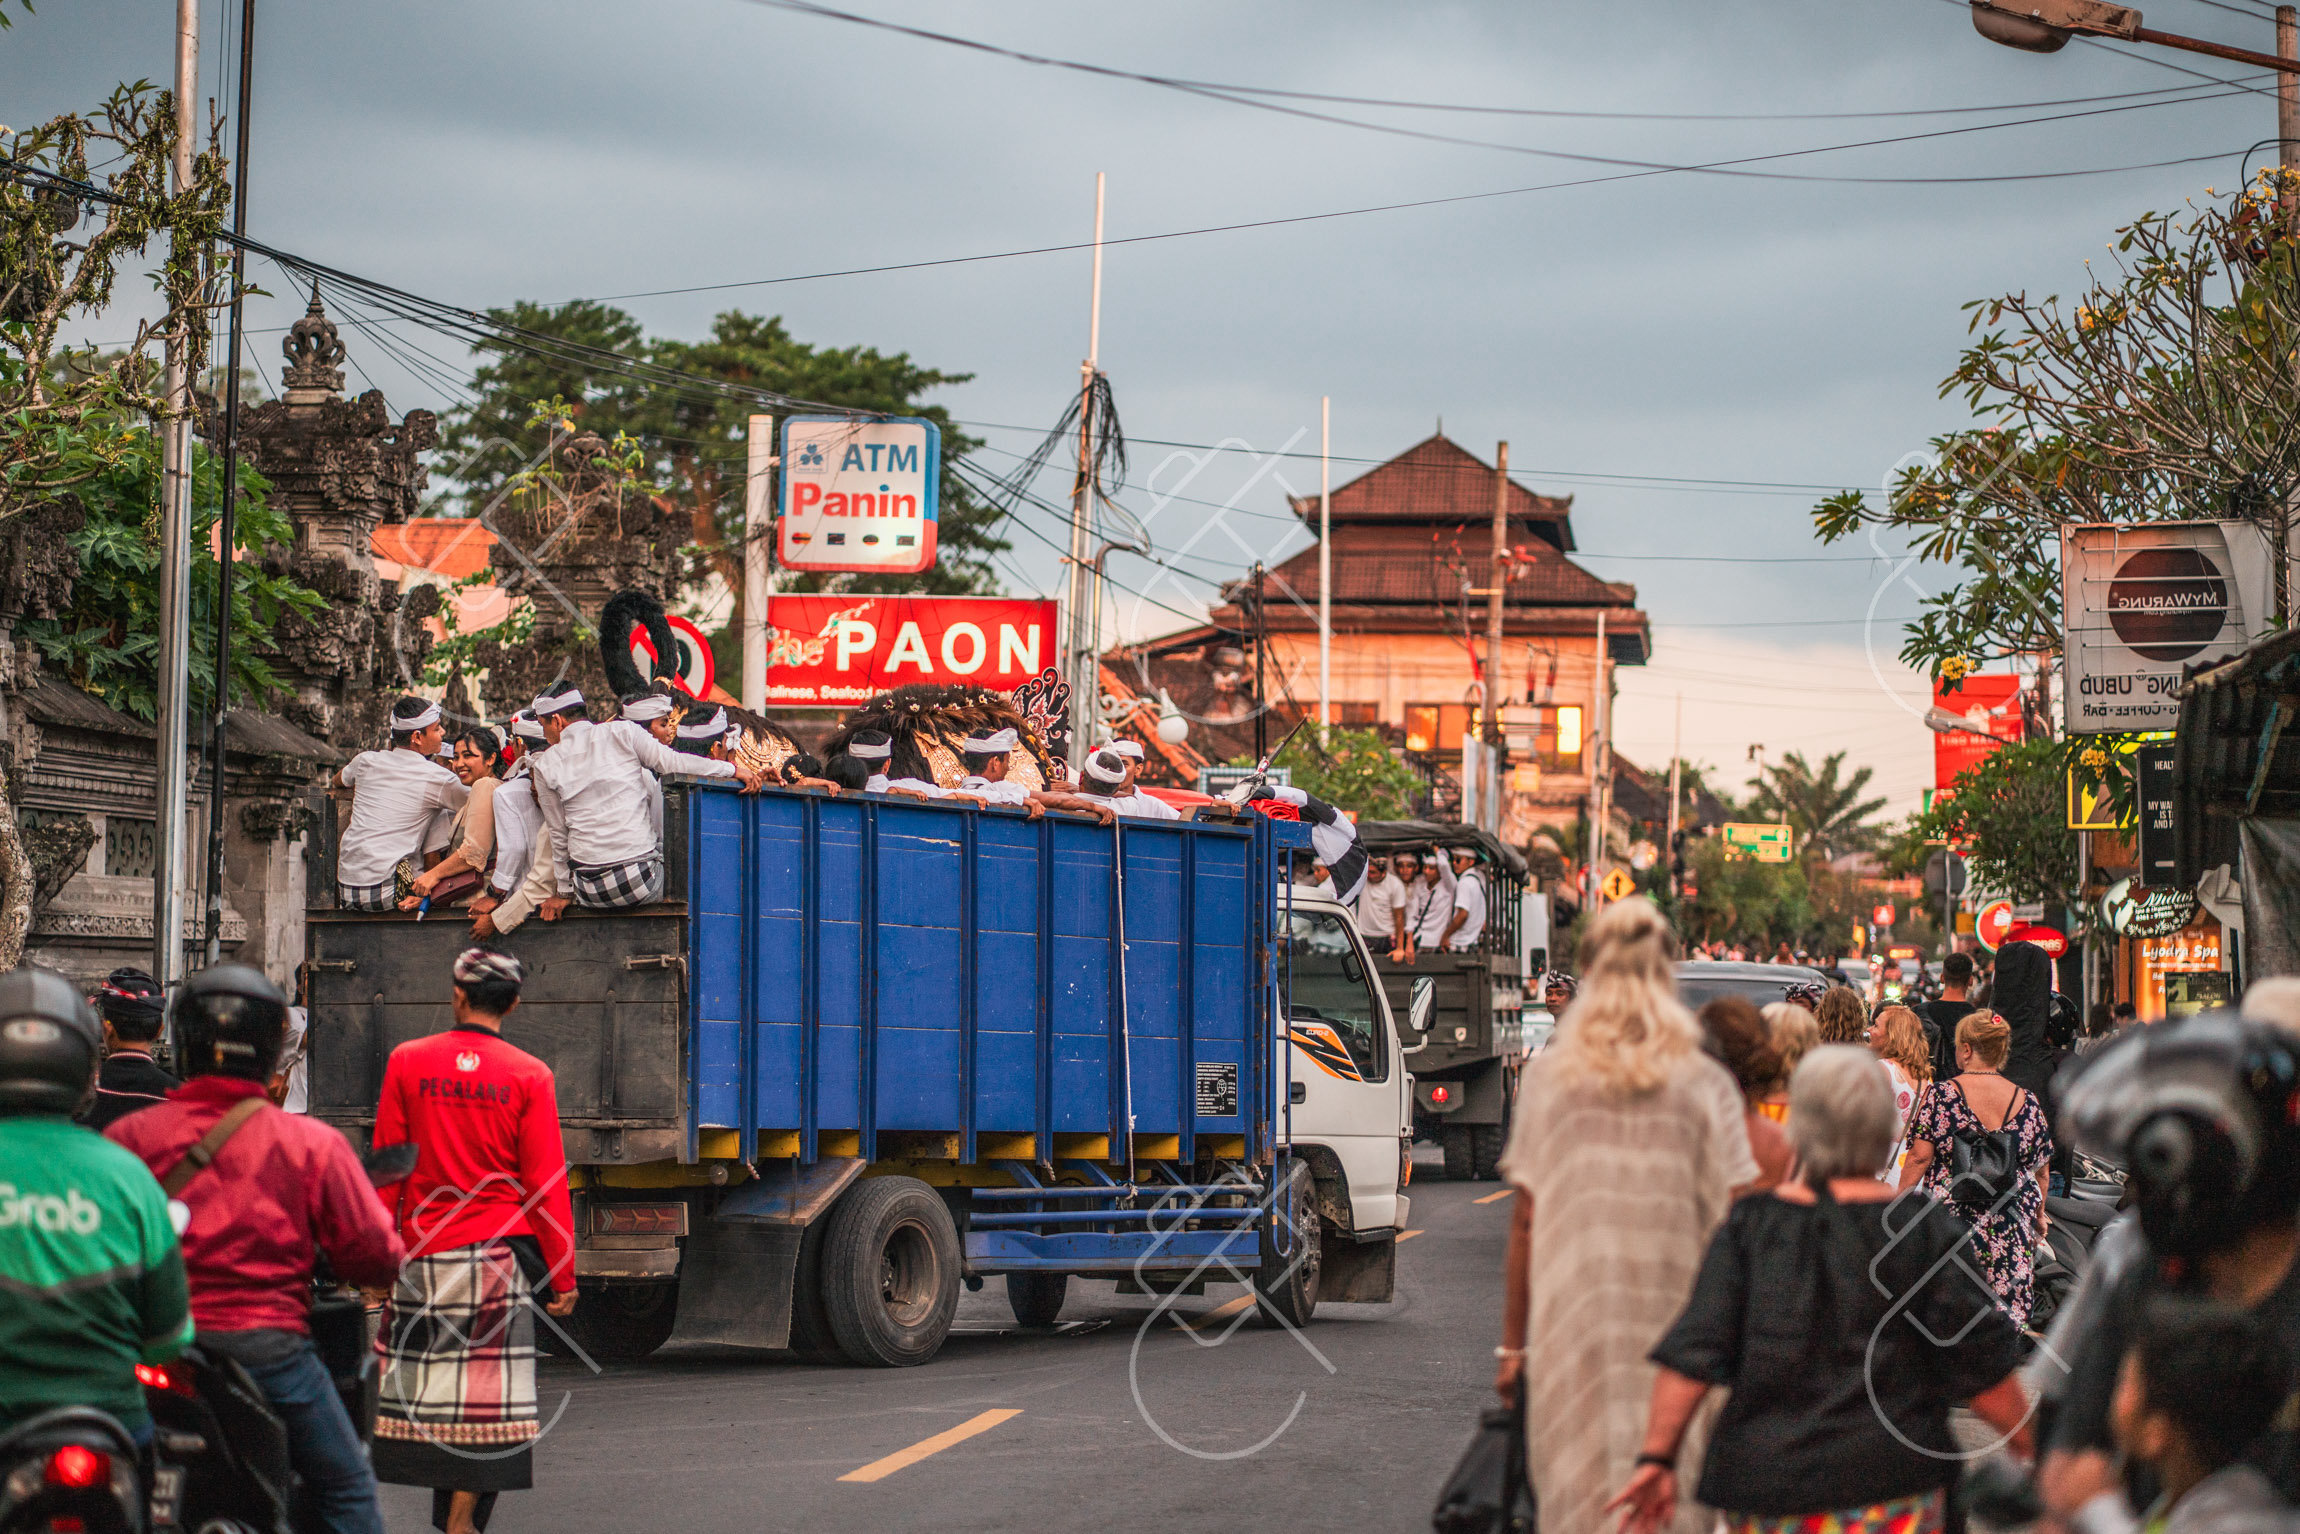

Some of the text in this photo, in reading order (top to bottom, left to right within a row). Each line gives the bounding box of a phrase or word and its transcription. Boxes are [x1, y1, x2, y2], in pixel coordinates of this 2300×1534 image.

[840, 443, 917, 473] ATM
[792, 482, 916, 518] Panin
[835, 620, 1041, 675] PAON
[2147, 801, 2159, 811] MY
[2153, 820, 2169, 829] AND
[2193, 944, 2219, 961] Spa
[419, 1077, 511, 1105] PECALANG
